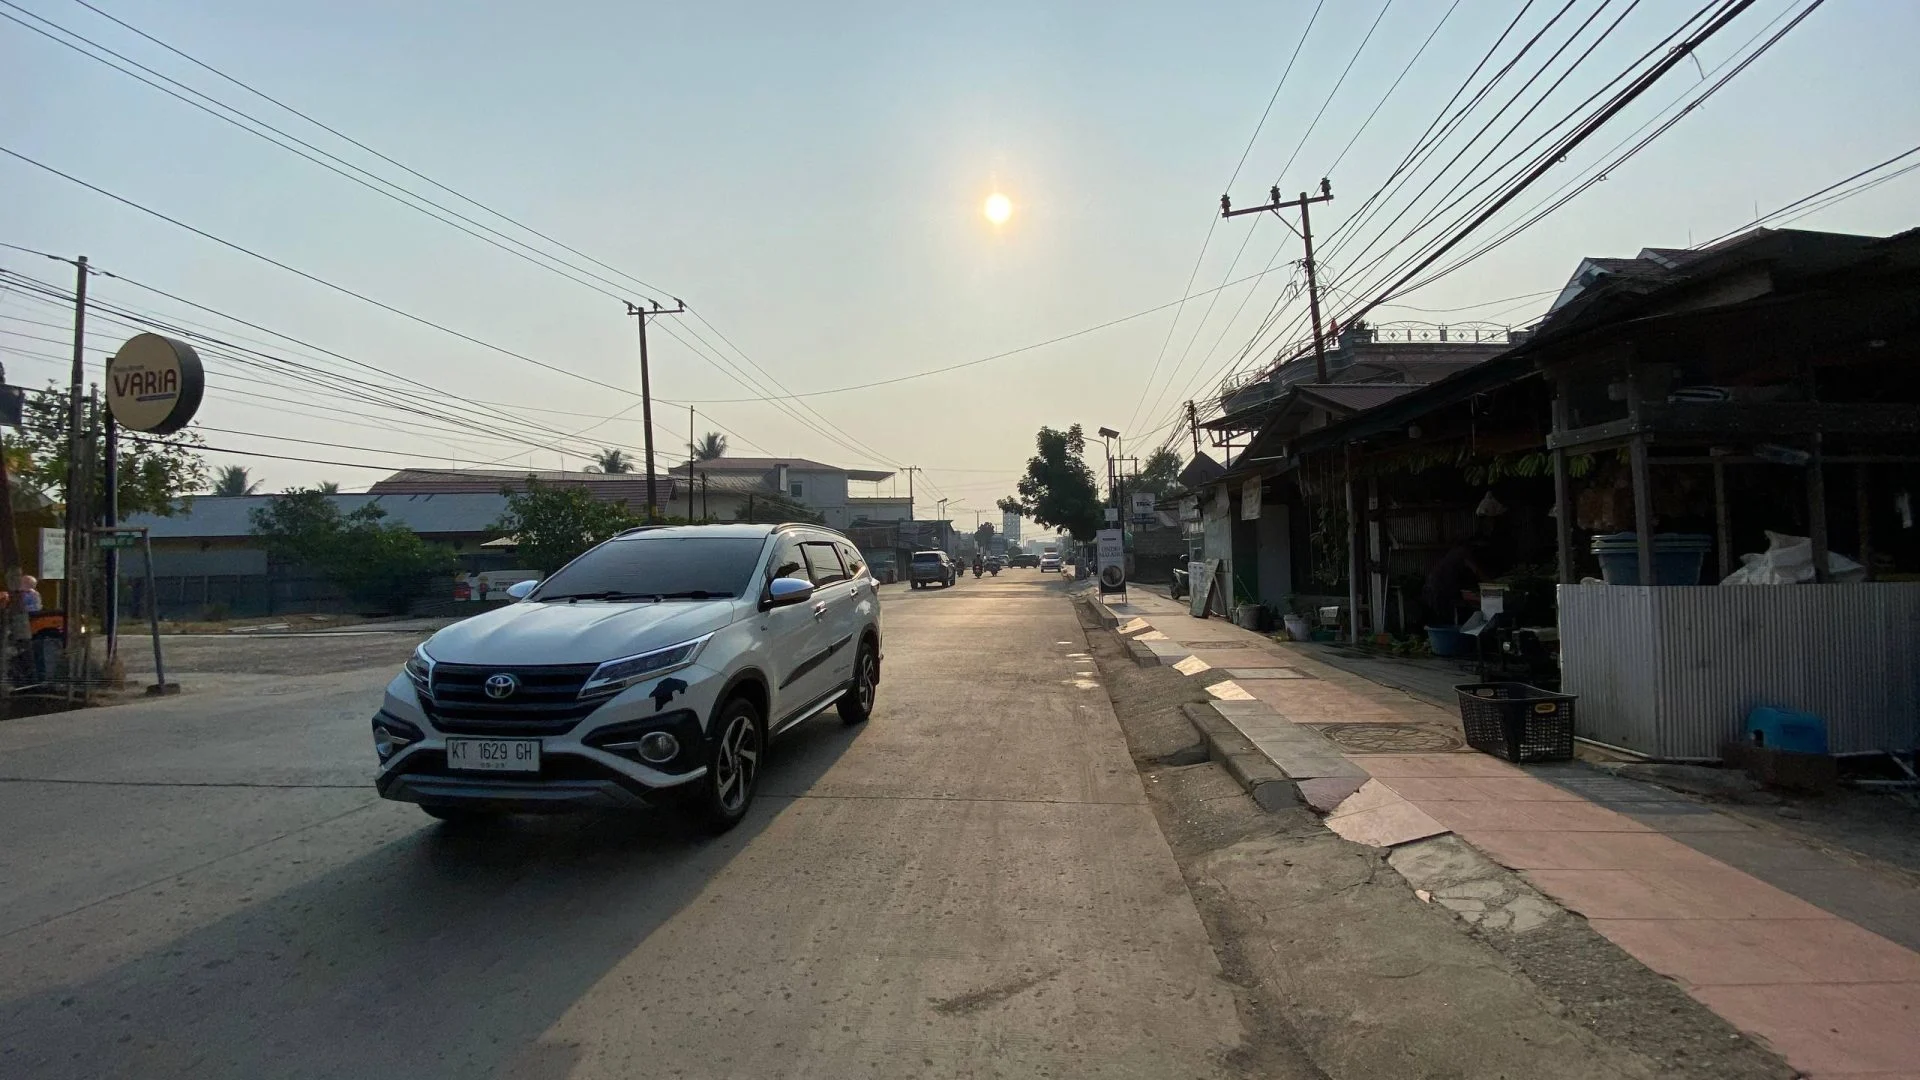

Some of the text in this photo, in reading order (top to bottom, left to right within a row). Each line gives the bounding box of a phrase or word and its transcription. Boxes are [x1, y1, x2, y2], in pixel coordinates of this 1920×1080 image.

[452, 742, 532, 760] KT 1629 GH
